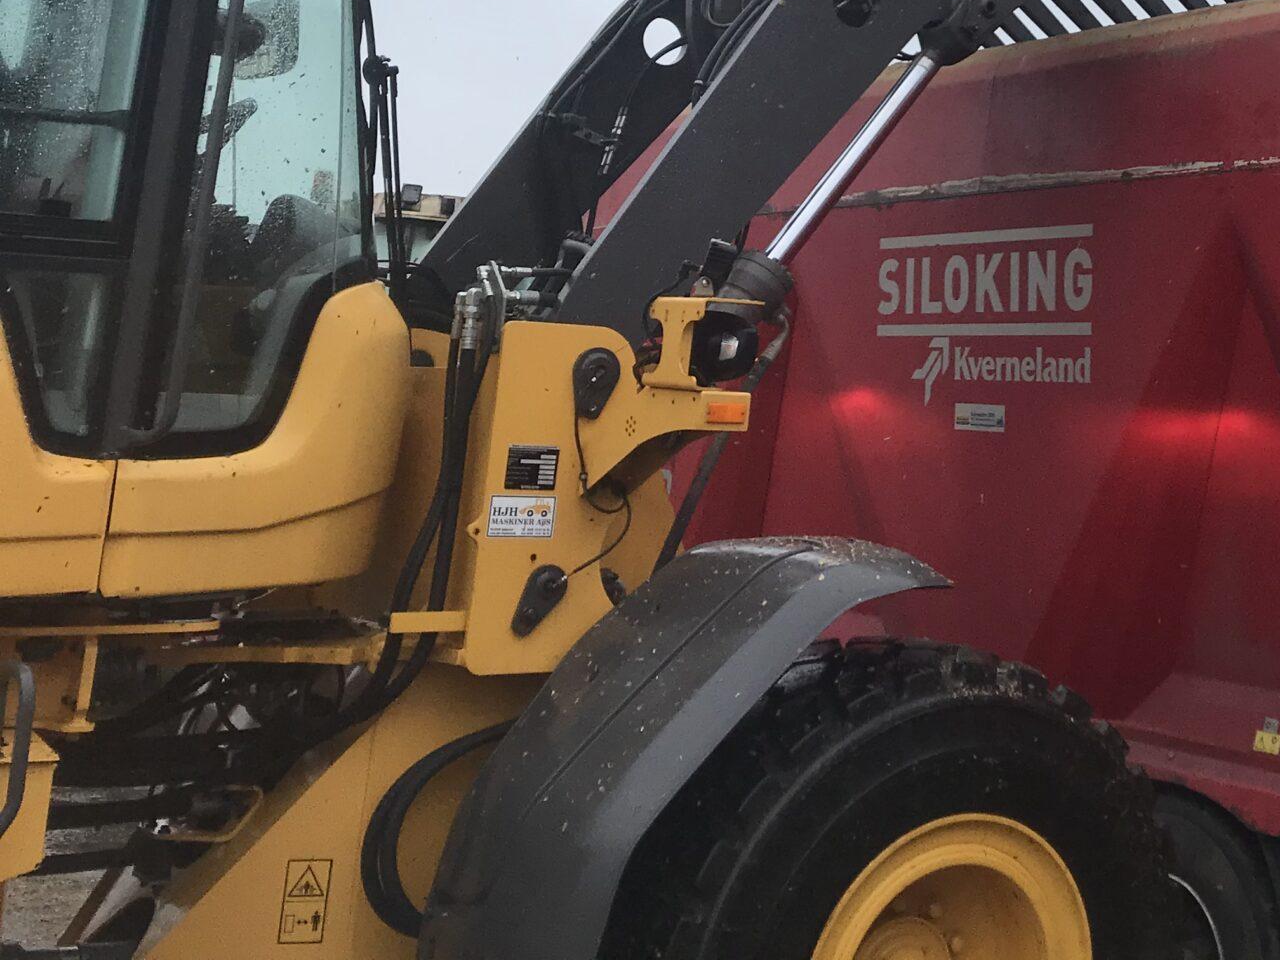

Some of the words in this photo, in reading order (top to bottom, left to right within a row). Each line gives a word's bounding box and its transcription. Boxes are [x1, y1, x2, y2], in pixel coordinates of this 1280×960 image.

[878, 247, 1093, 315] SILOKING
[953, 346, 1091, 384] Kverneland
[491, 518, 535, 526] MASKINER
[492, 506, 518, 517] HJH
